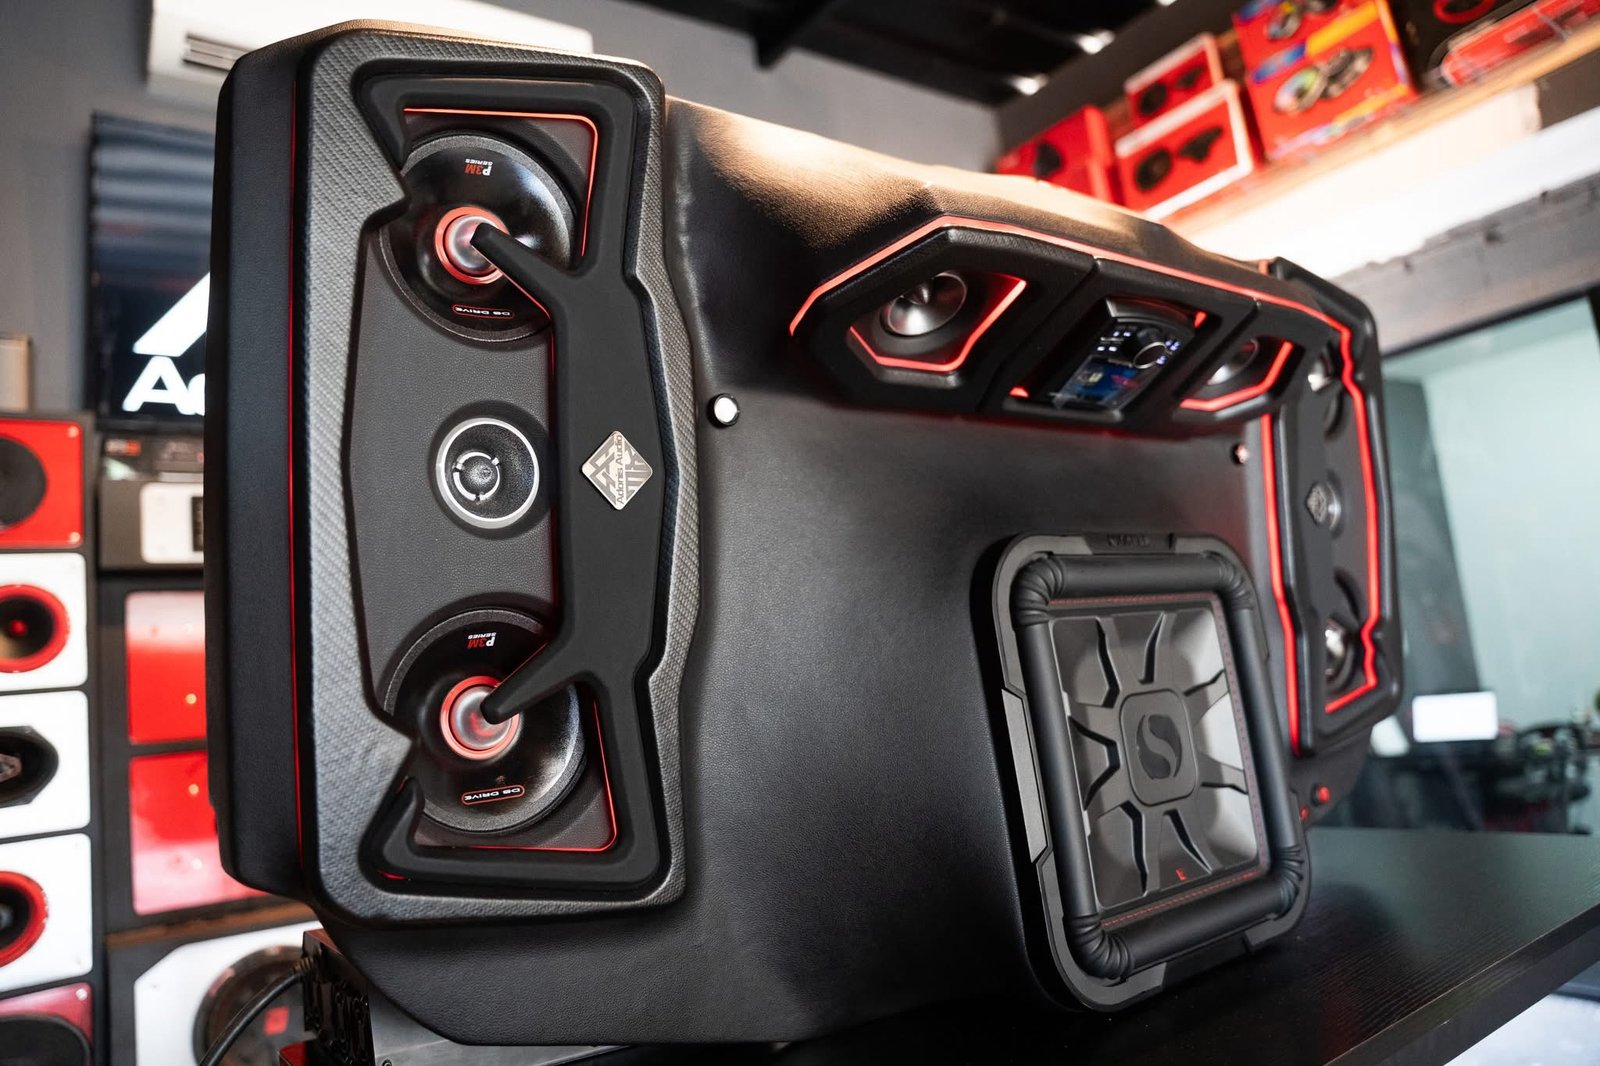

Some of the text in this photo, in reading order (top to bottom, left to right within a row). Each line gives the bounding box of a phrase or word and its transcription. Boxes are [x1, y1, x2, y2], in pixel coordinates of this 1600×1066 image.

[465, 158, 493, 166] SERIES
[465, 163, 492, 176] P3M
[455, 306, 490, 315] DRIVE
[615, 434, 625, 505] Adonis Audio
[467, 632, 497, 640] SERIES
[467, 636, 496, 649] P3M
[463, 791, 500, 801] DRIVE
